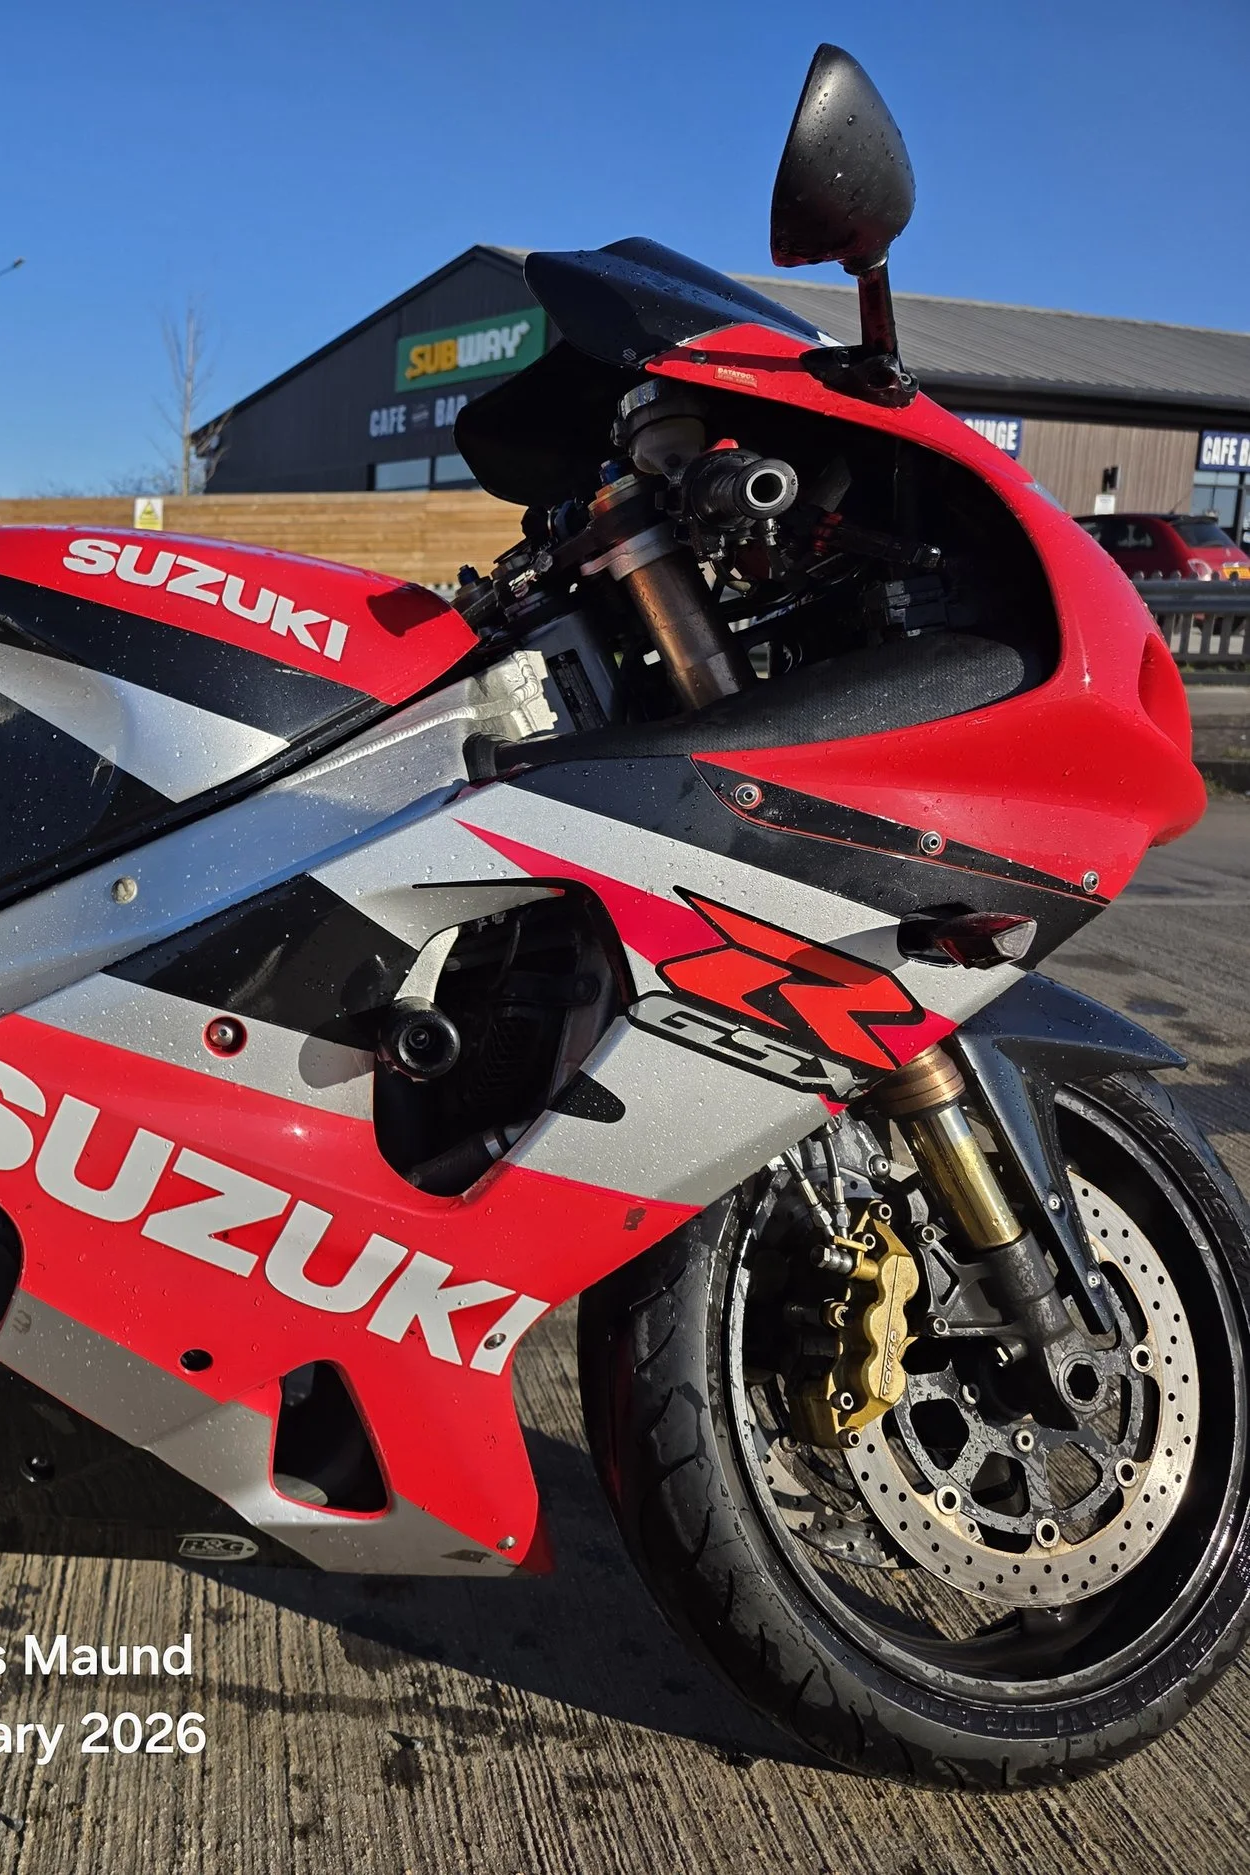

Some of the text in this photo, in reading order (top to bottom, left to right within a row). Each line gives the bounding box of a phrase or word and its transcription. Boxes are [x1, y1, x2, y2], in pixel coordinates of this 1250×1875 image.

[405, 320, 530, 381] SUBWAY
[369, 405, 407, 437] CAFE
[963, 418, 1018, 450] UNGE
[1202, 435, 1250, 467] CAFE B
[62, 538, 350, 663] SUZUKI
[881, 1330, 899, 1396] TOKICO
